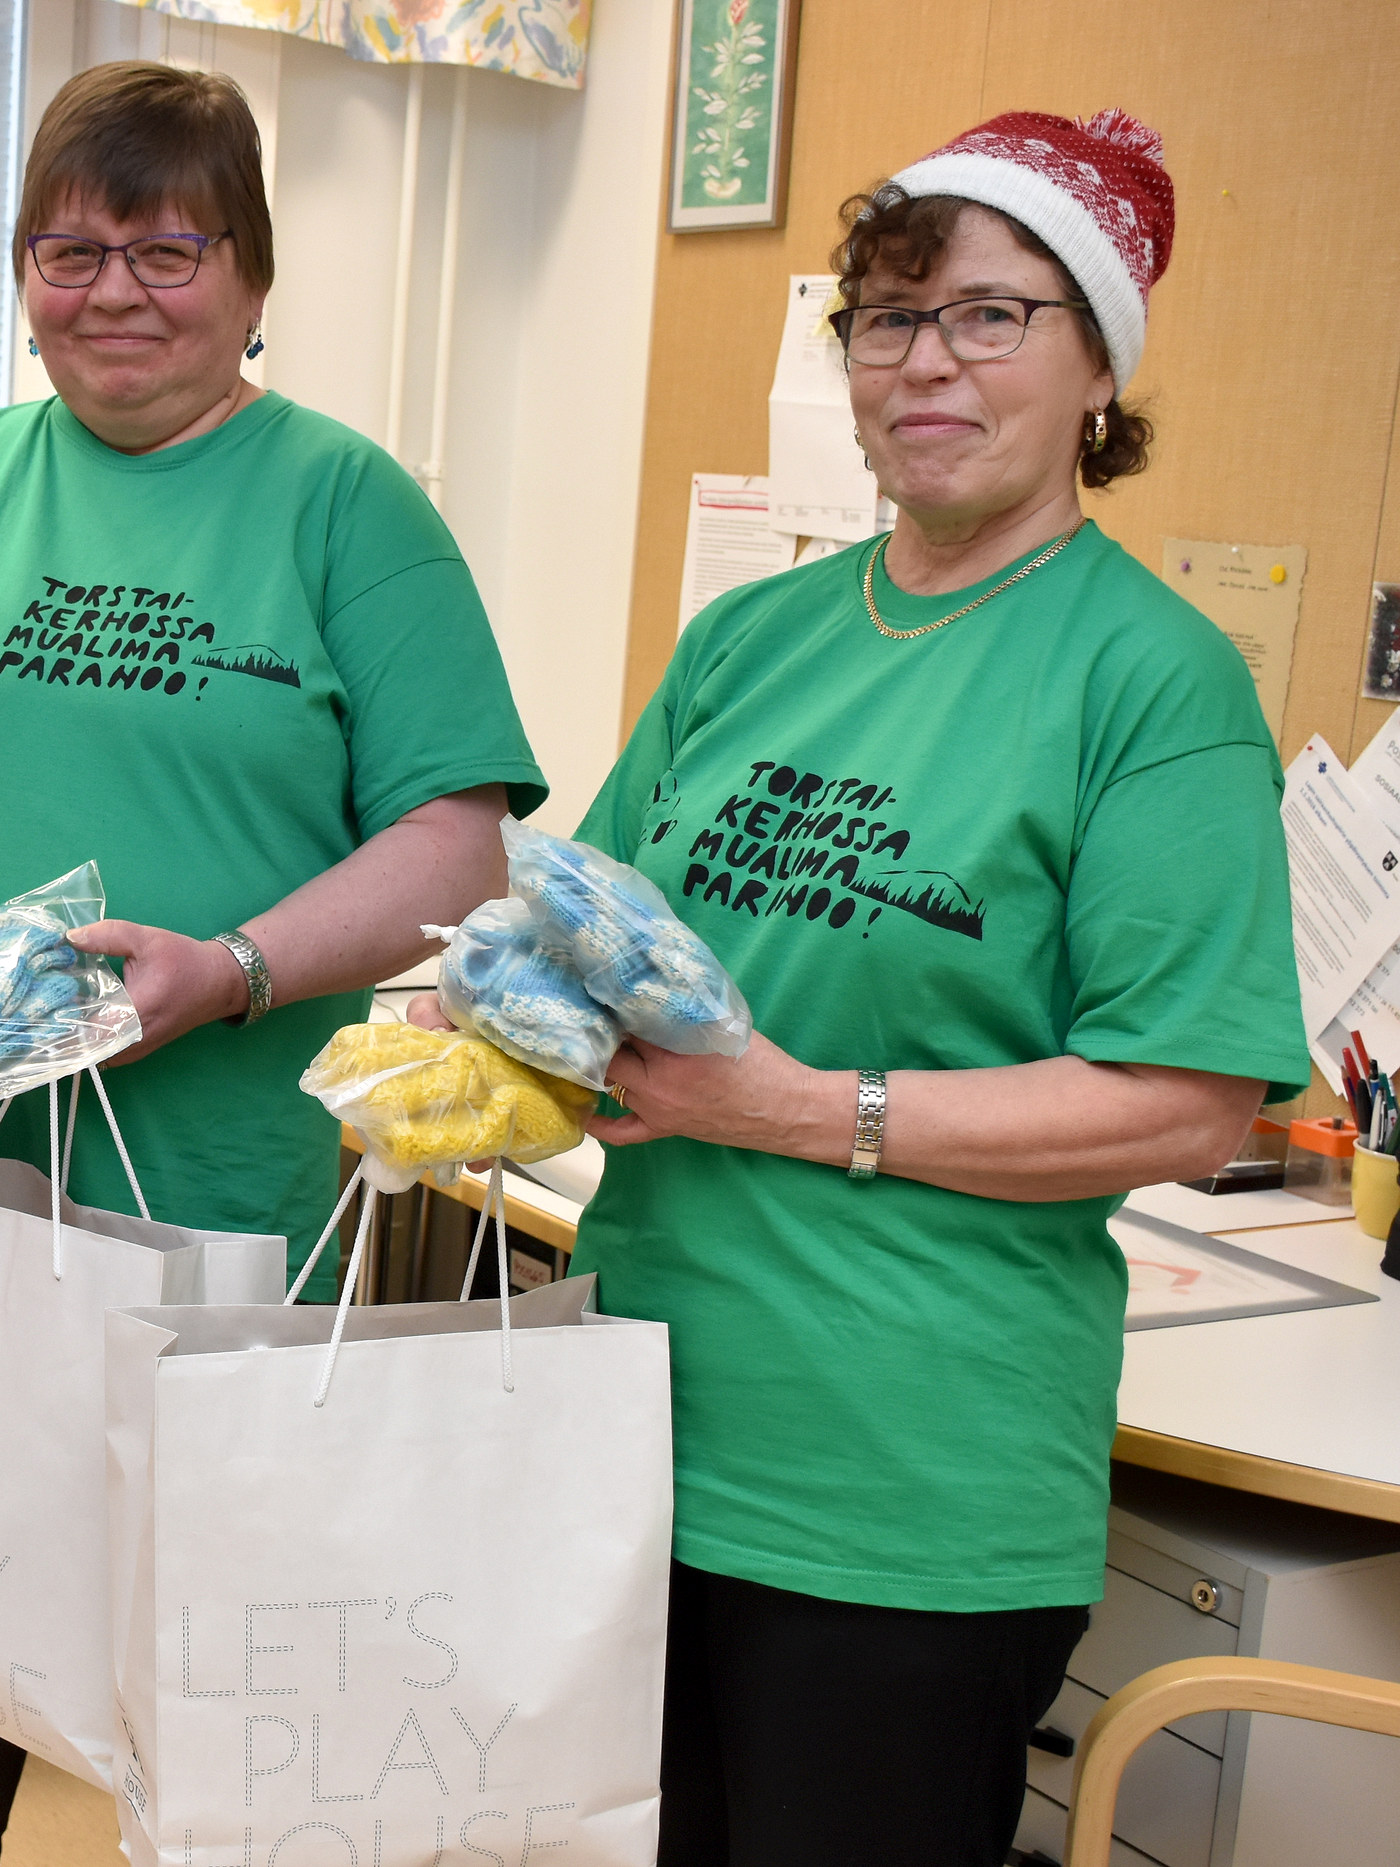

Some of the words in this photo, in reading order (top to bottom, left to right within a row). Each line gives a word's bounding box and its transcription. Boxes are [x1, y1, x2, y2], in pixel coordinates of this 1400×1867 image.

[42, 576, 194, 611] TORSTAI-
[3, 625, 180, 665] MUALIMA
[23, 600, 215, 644] KERHOSSA
[747, 761, 897, 811] TORSTAI-
[714, 794, 911, 860] KERHOSSA
[688, 828, 860, 887] MUALIMA
[182, 1592, 459, 1698] LET'S
[245, 1702, 518, 1807] PLAY
